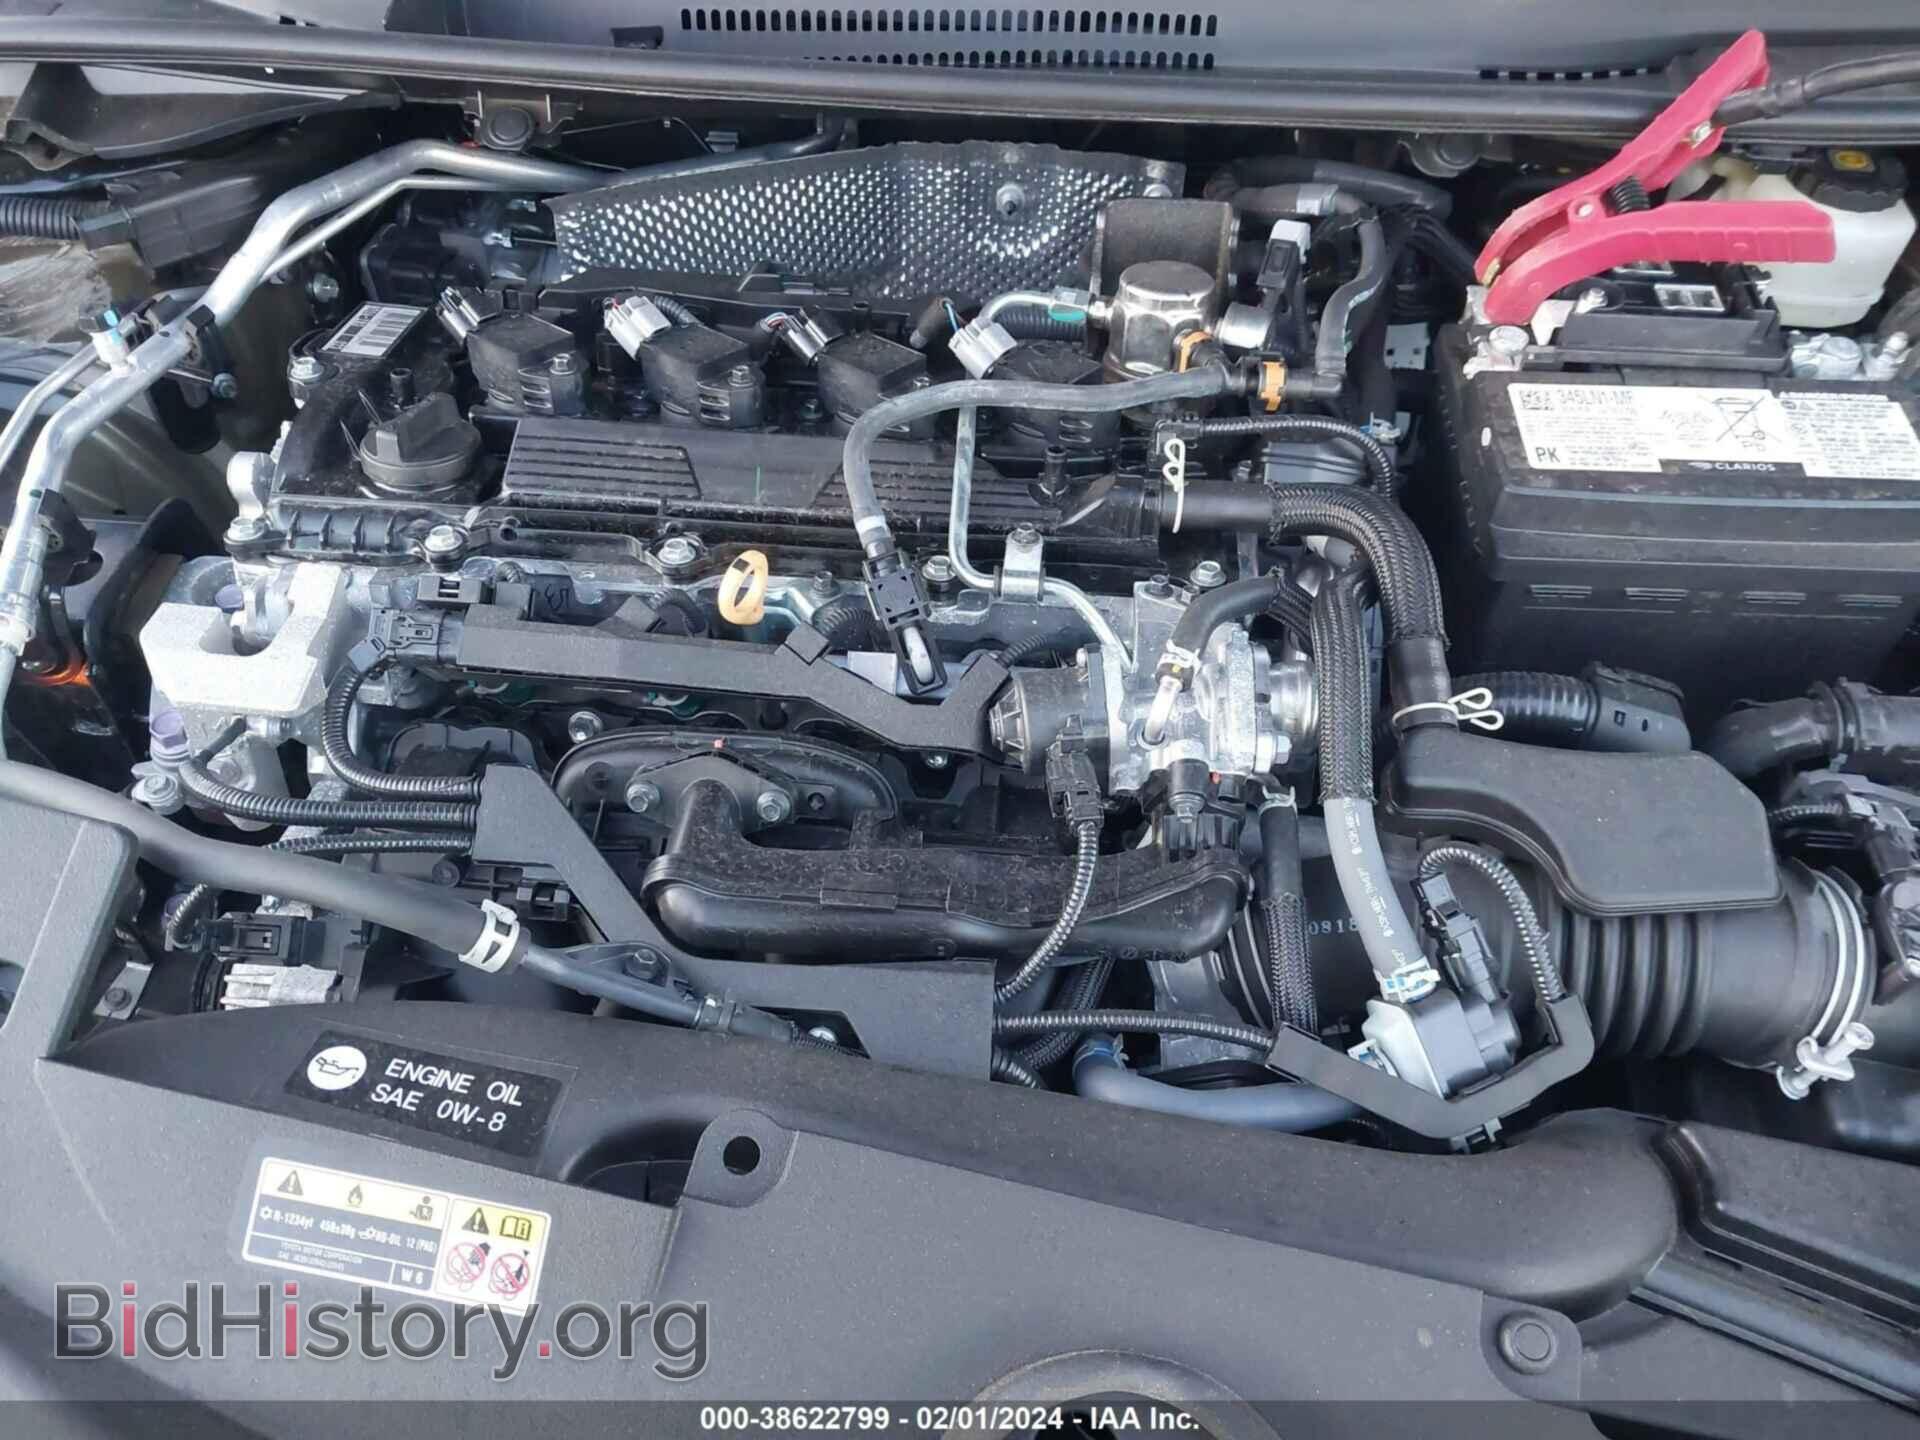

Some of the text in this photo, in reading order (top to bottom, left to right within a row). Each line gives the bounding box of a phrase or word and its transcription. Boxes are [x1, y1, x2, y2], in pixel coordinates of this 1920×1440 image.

[1535, 447, 1561, 463] PK
[1715, 462, 1777, 472] CLARIOS
[386, 1058, 524, 1107] ENGINE OIL
[370, 1083, 508, 1133] SAE 0W-8
[401, 1268, 413, 1282] W
